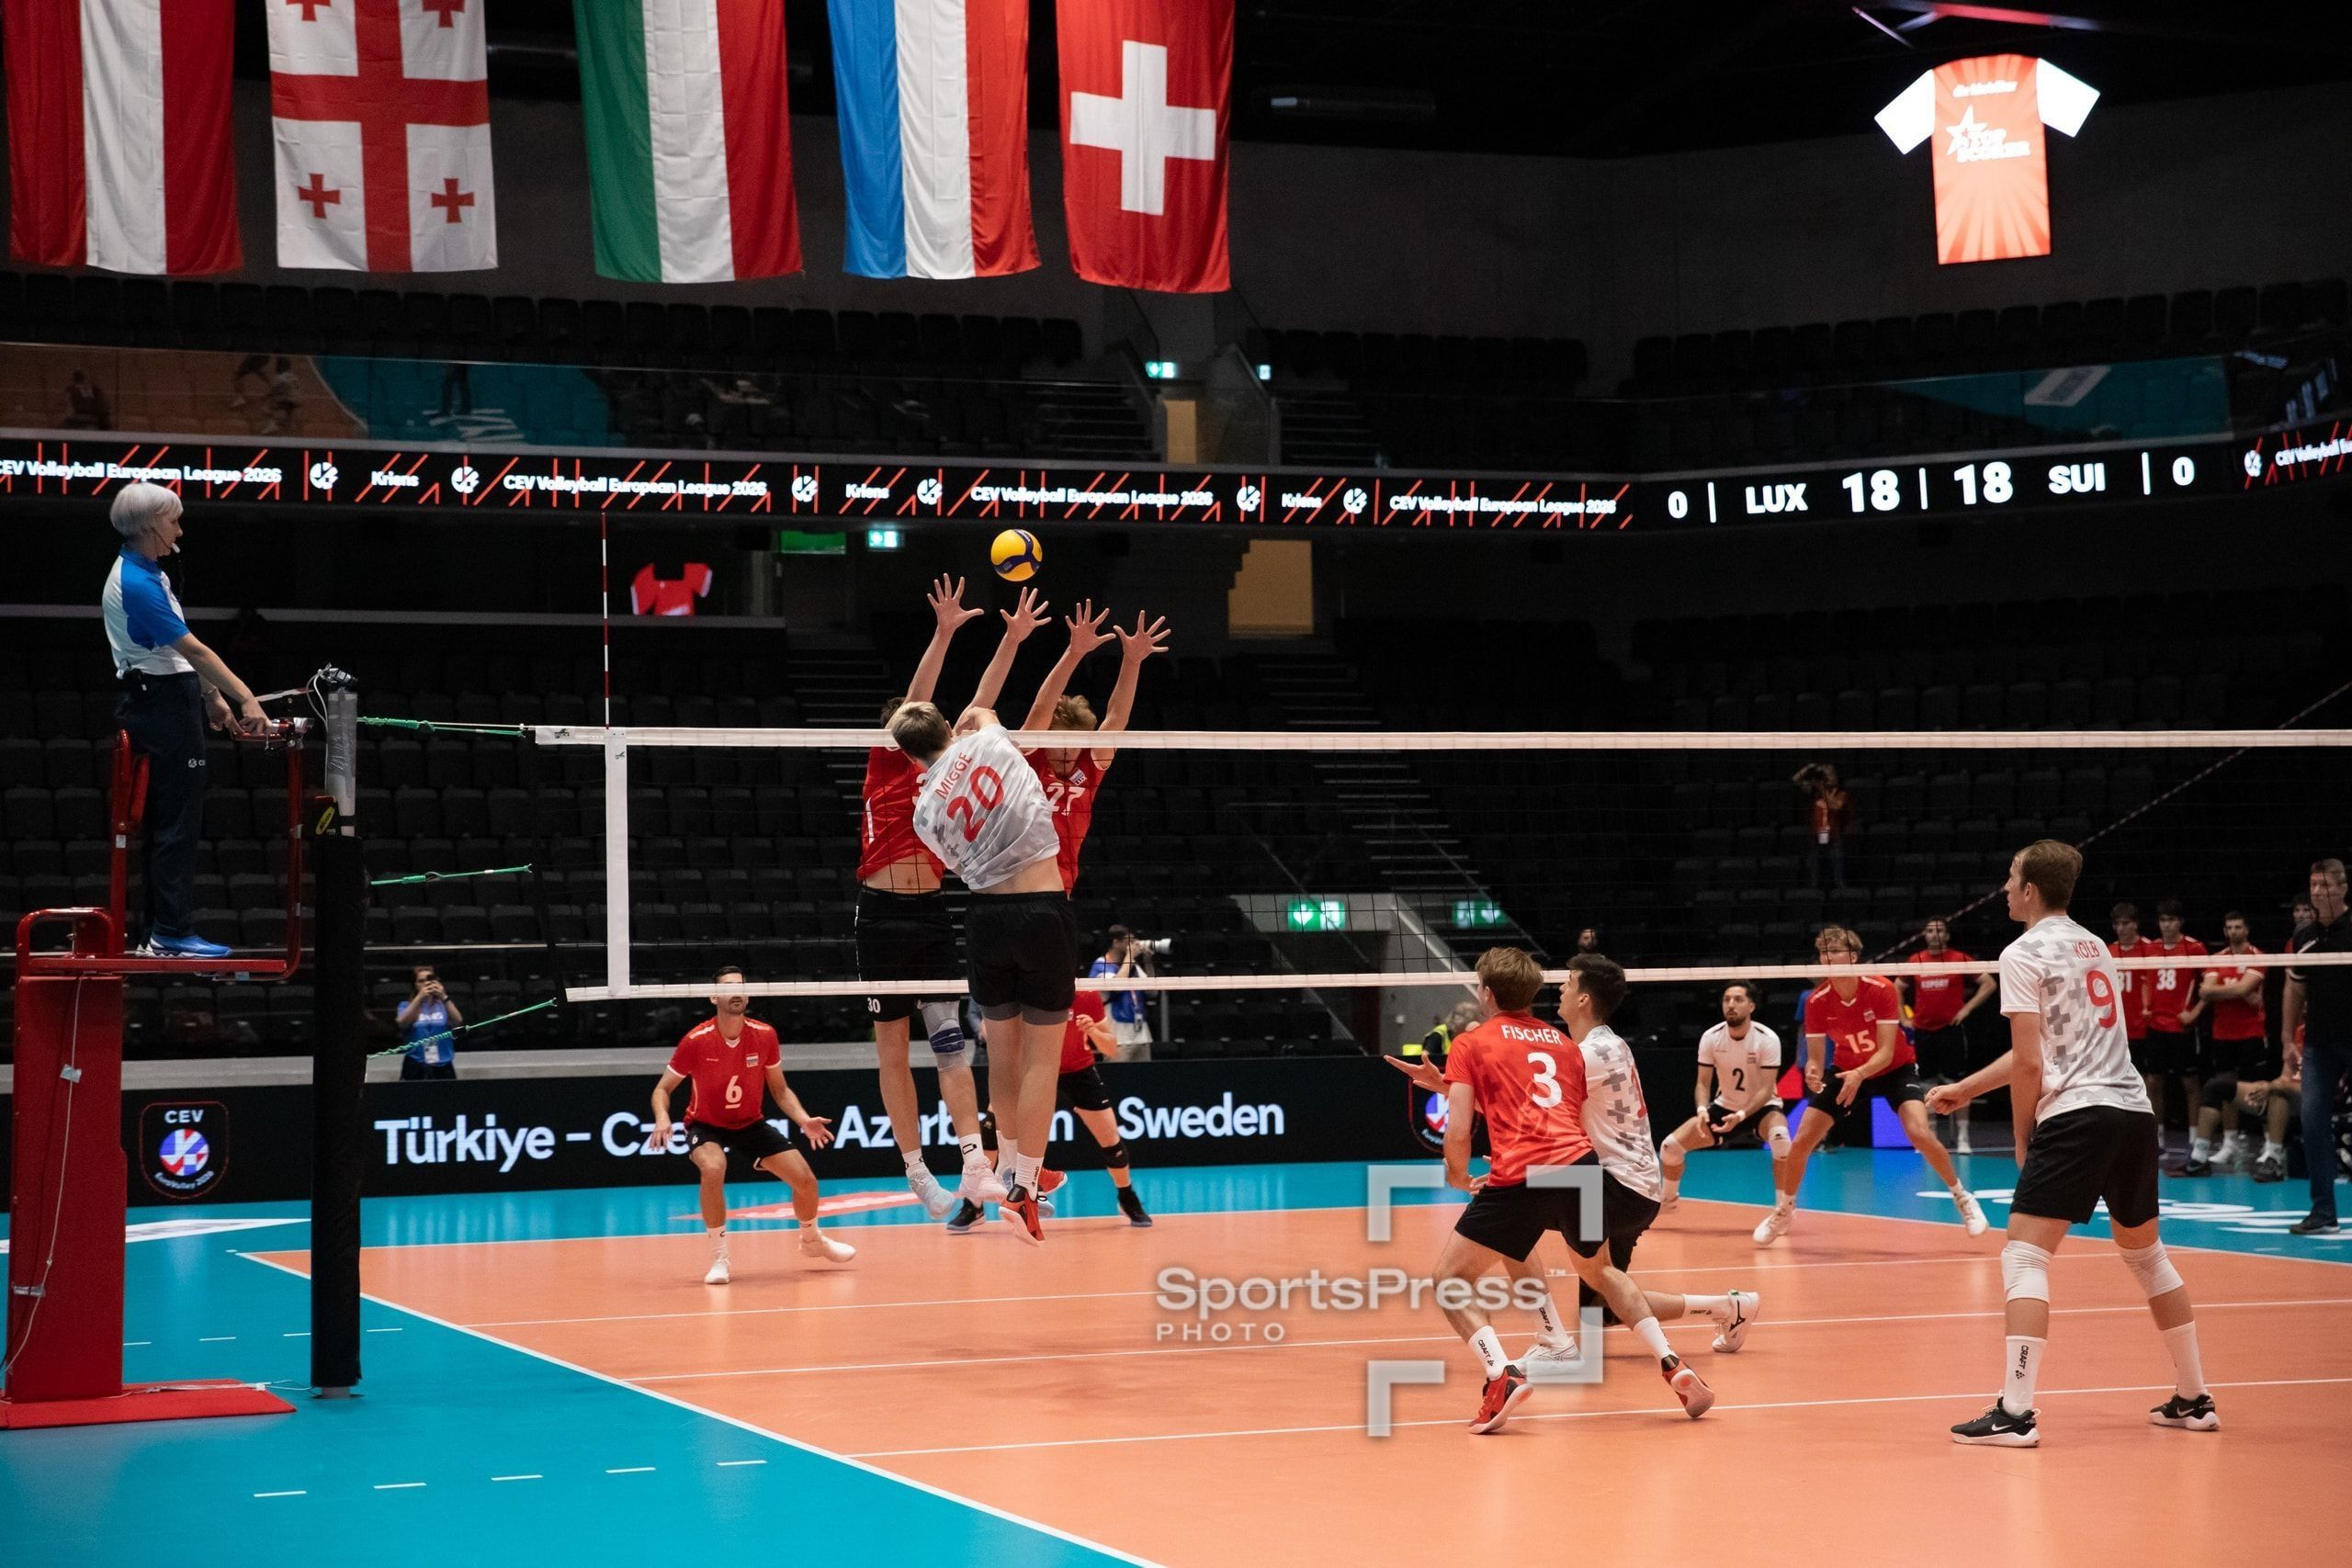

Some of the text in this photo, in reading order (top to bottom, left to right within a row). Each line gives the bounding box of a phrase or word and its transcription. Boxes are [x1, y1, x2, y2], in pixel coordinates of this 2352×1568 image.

[27, 461, 105, 479] Volleyball
[107, 463, 181, 482] European
[184, 466, 243, 484] League
[243, 467, 281, 483] 2026
[371, 471, 419, 488] Kriens
[503, 475, 767, 498] CEV Volleyball European League 2026
[846, 483, 889, 500] Kriens
[970, 487, 1000, 502] CEV
[1001, 487, 1066, 505] Volleyball
[1068, 490, 1129, 506] European
[1131, 491, 1179, 508] League
[1668, 457, 2195, 518] 0 LUX 18 18 SUI 0
[1282, 492, 1323, 509] Kriens
[1390, 496, 1418, 511] CEV
[1419, 496, 1478, 513] Volleyball
[1480, 497, 1538, 514] European
[1540, 499, 1585, 515] League
[934, 751, 972, 800] MIGGE
[946, 765, 1004, 843] 20
[1046, 782, 1086, 816] 27
[2073, 941, 2100, 958] KOLB
[867, 997, 881, 1013] 30
[2086, 970, 2118, 1029] 9
[1501, 1024, 1563, 1044] FISCHER
[1845, 1030, 1876, 1055] 15
[726, 1076, 742, 1104] 6
[1527, 1052, 1562, 1109] 3
[1732, 1067, 1745, 1091] 2
[164, 1110, 203, 1123] CEV
[1118, 1093, 1283, 1140] Sweden
[375, 1113, 555, 1172] Türkiye
[1477, 1339, 1491, 1359] CRAFT
[2018, 1345, 2029, 1370] CRAFT
